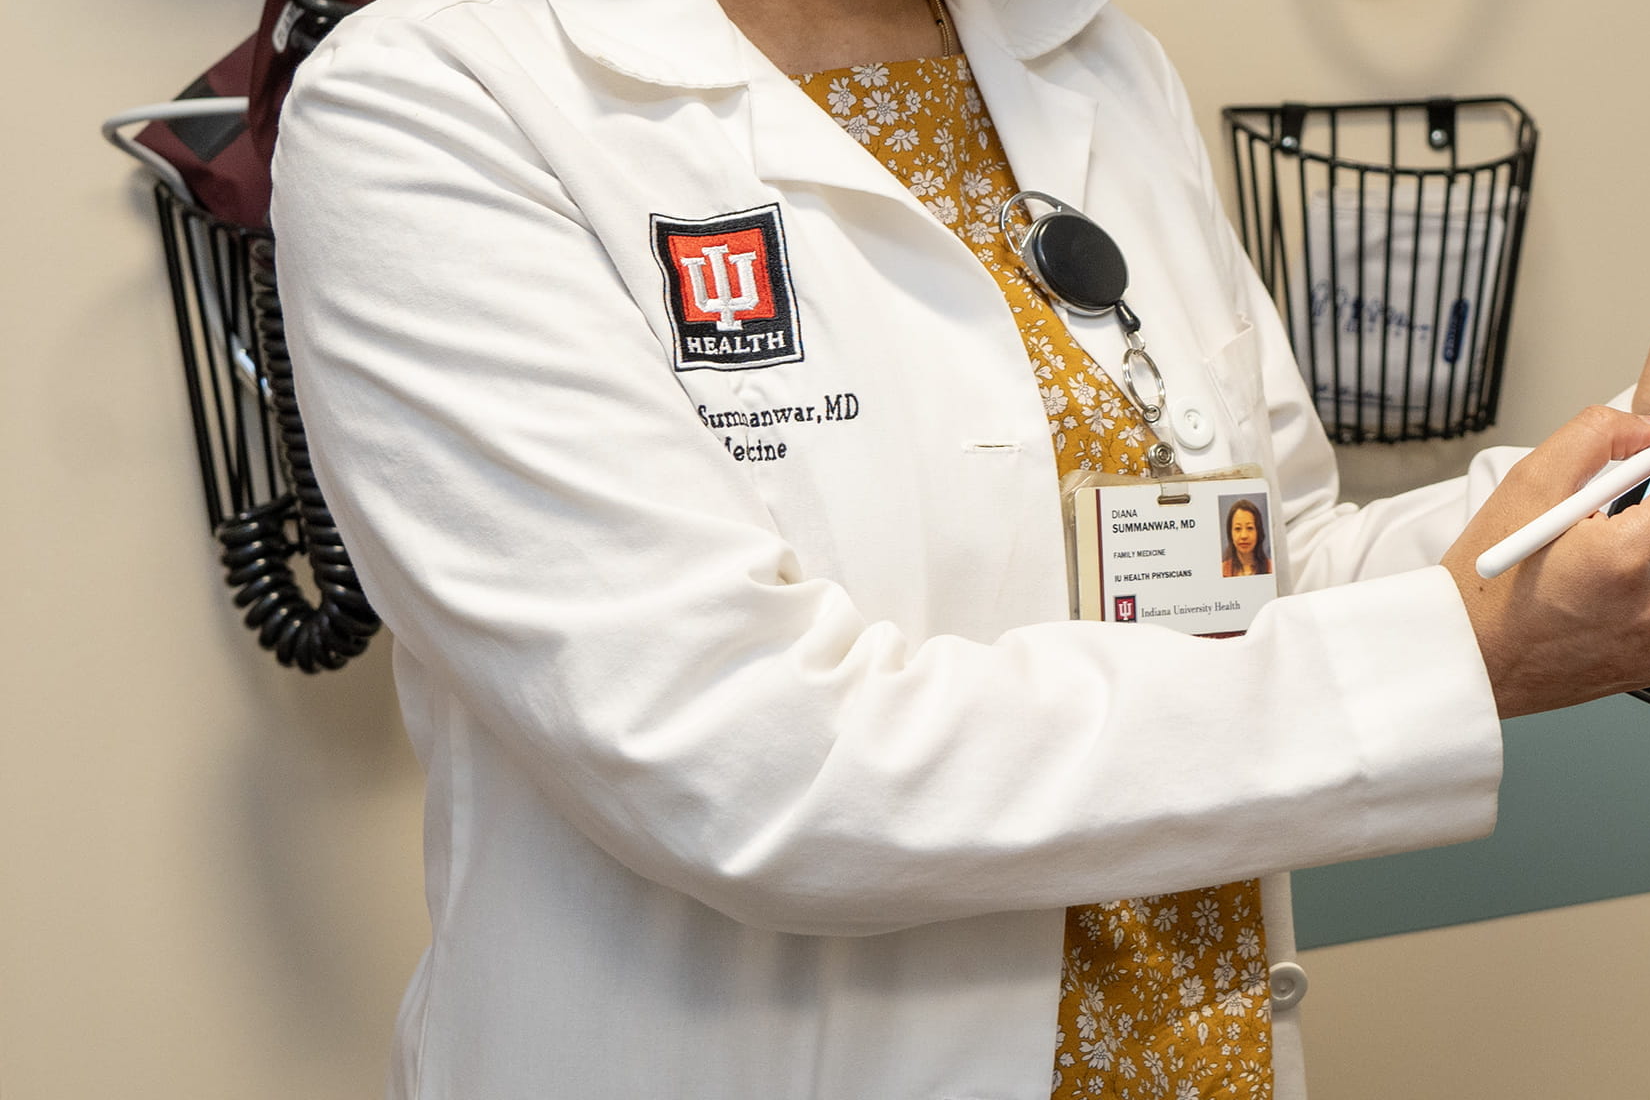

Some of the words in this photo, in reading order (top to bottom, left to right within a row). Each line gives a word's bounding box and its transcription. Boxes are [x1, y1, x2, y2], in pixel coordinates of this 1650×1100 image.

[685, 330, 787, 356] HEALTH
[1111, 509, 1138, 519] DIANA
[1112, 520, 1179, 534] SUMMANWAR,
[1180, 519, 1196, 529] MD
[1113, 551, 1135, 559] FAMILY
[1137, 548, 1166, 557] MEDICINE
[1114, 575, 1122, 583] IU
[1123, 572, 1150, 582] HEALTH
[1151, 569, 1192, 580] PHYSICIANS
[1141, 607, 1171, 618] Indiana
[1173, 604, 1212, 616] University
[1214, 600, 1241, 612] Health
